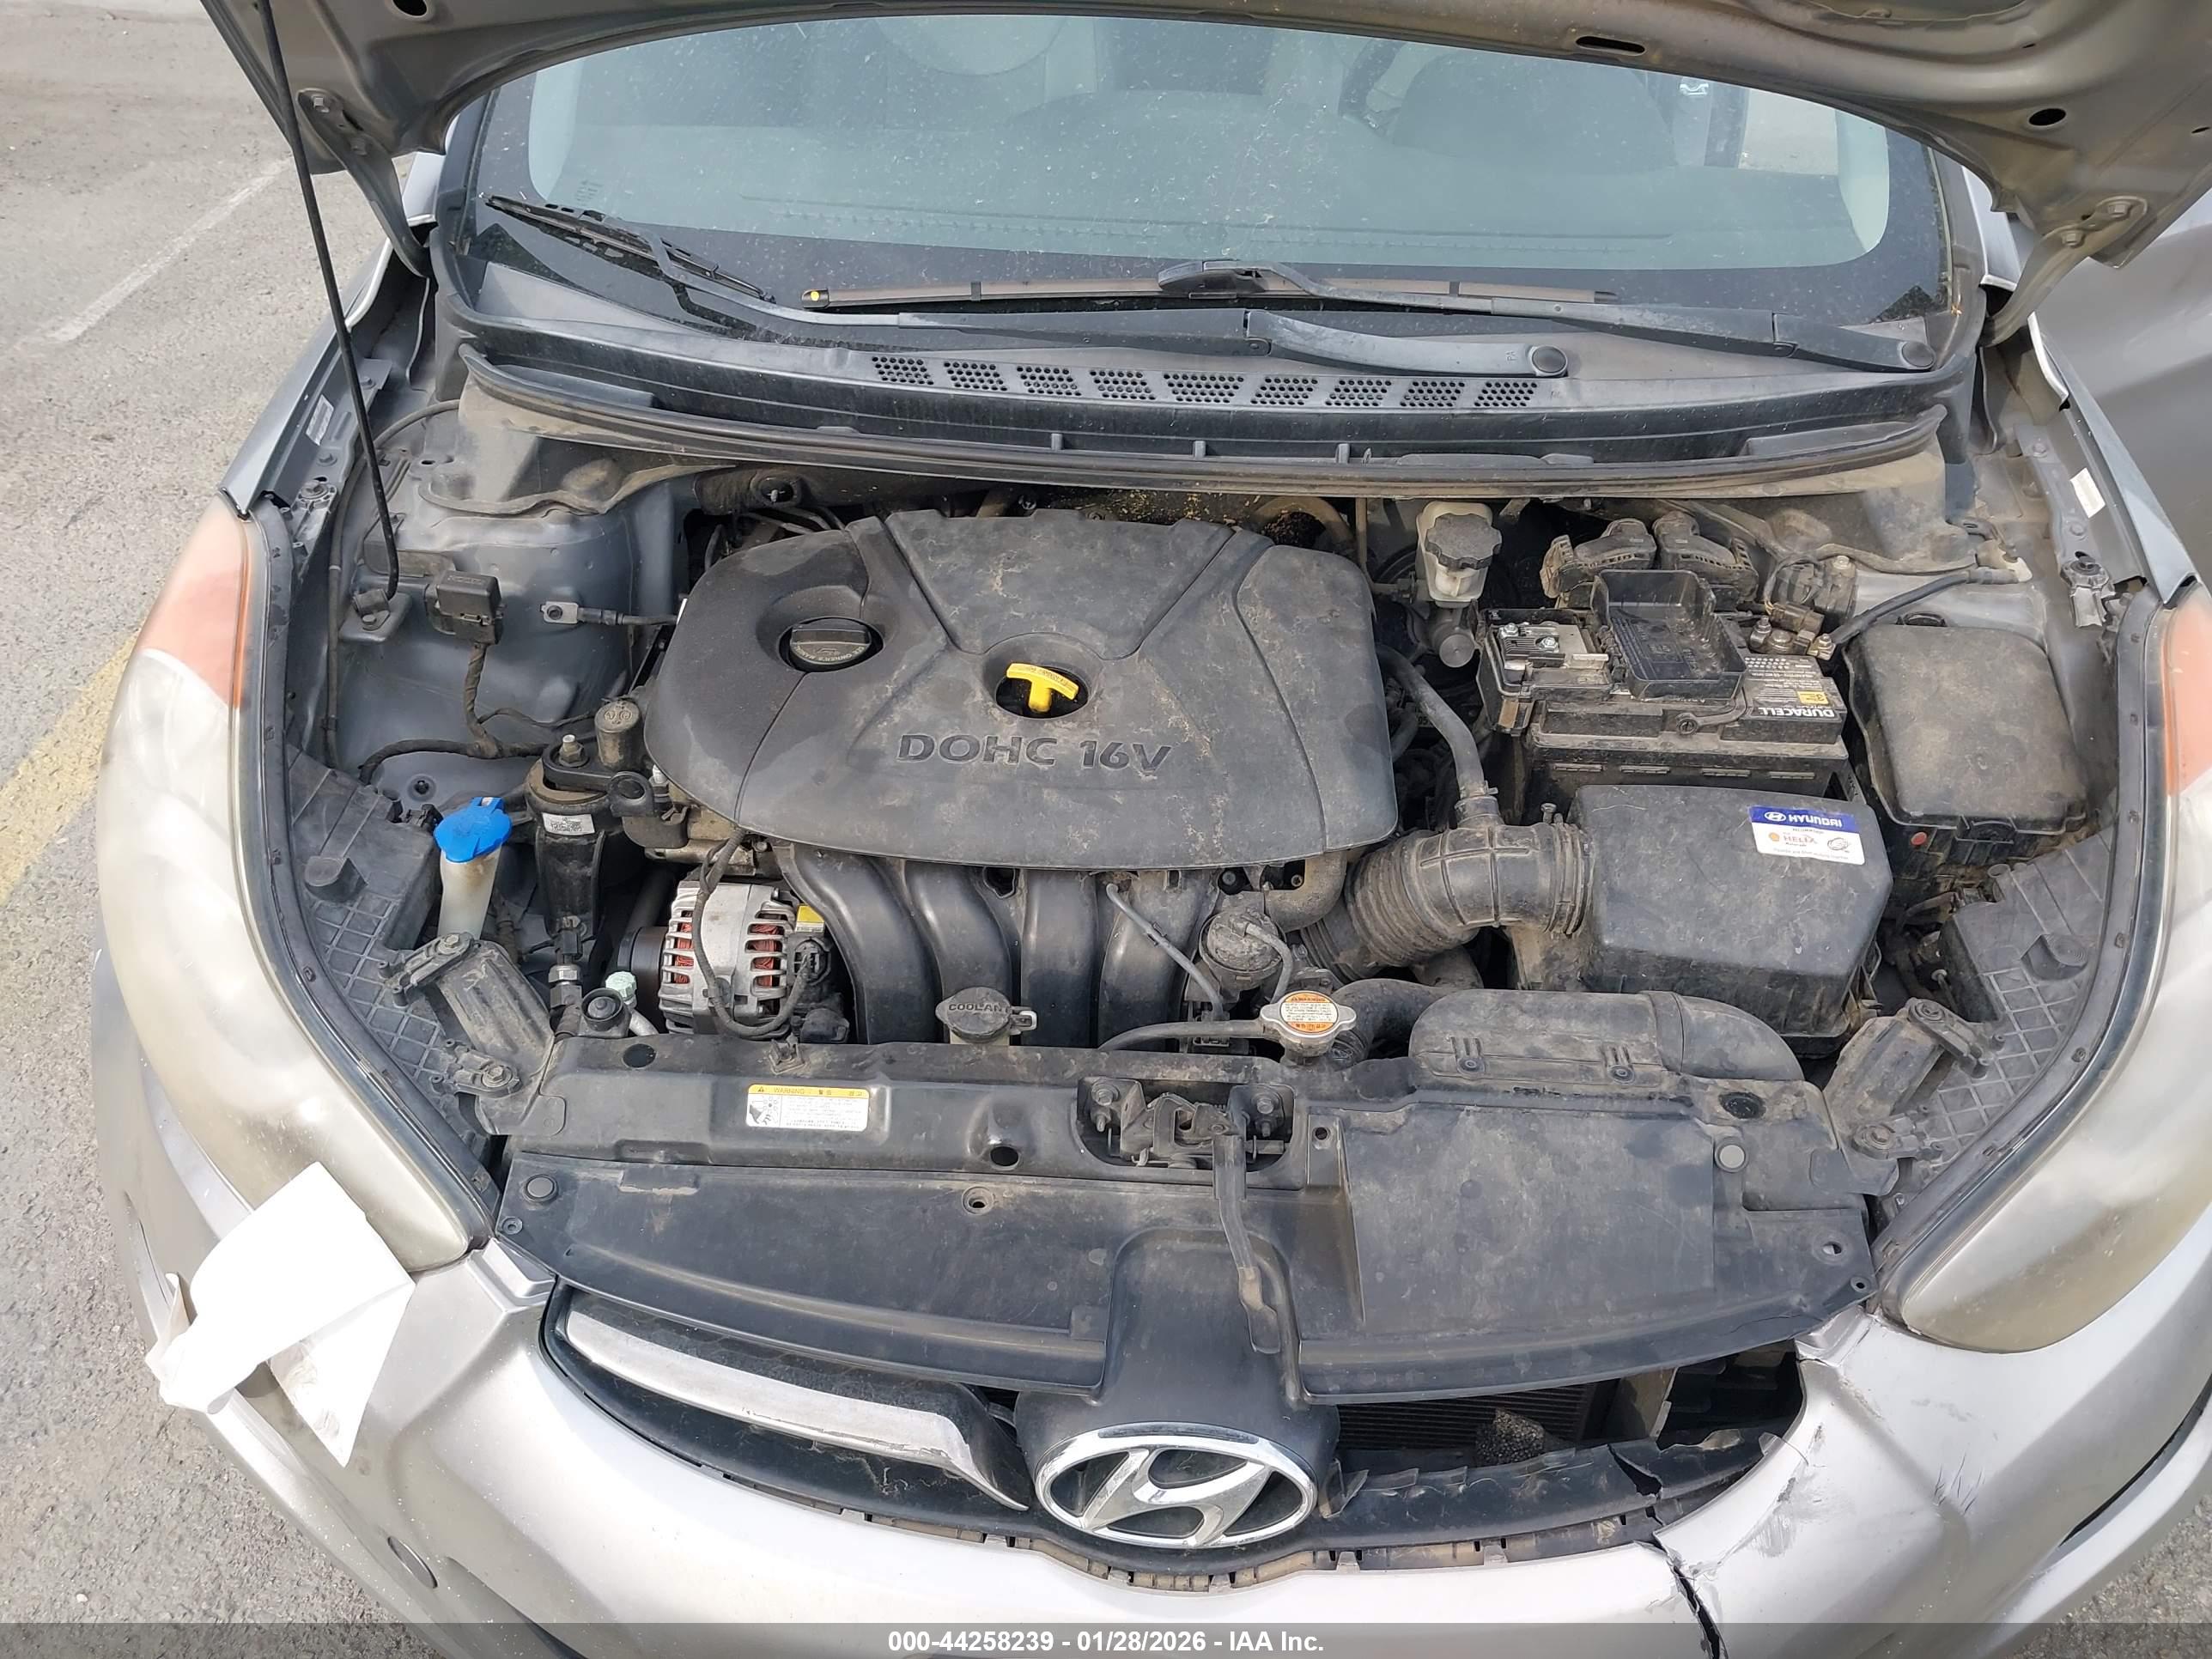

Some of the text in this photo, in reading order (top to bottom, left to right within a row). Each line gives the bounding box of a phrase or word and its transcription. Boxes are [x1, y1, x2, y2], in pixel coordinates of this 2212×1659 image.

[1758, 707, 1835, 717] DURACELL
[897, 734, 1172, 772] DOHC 16V
[1789, 814, 1843, 827] HYUNDAI
